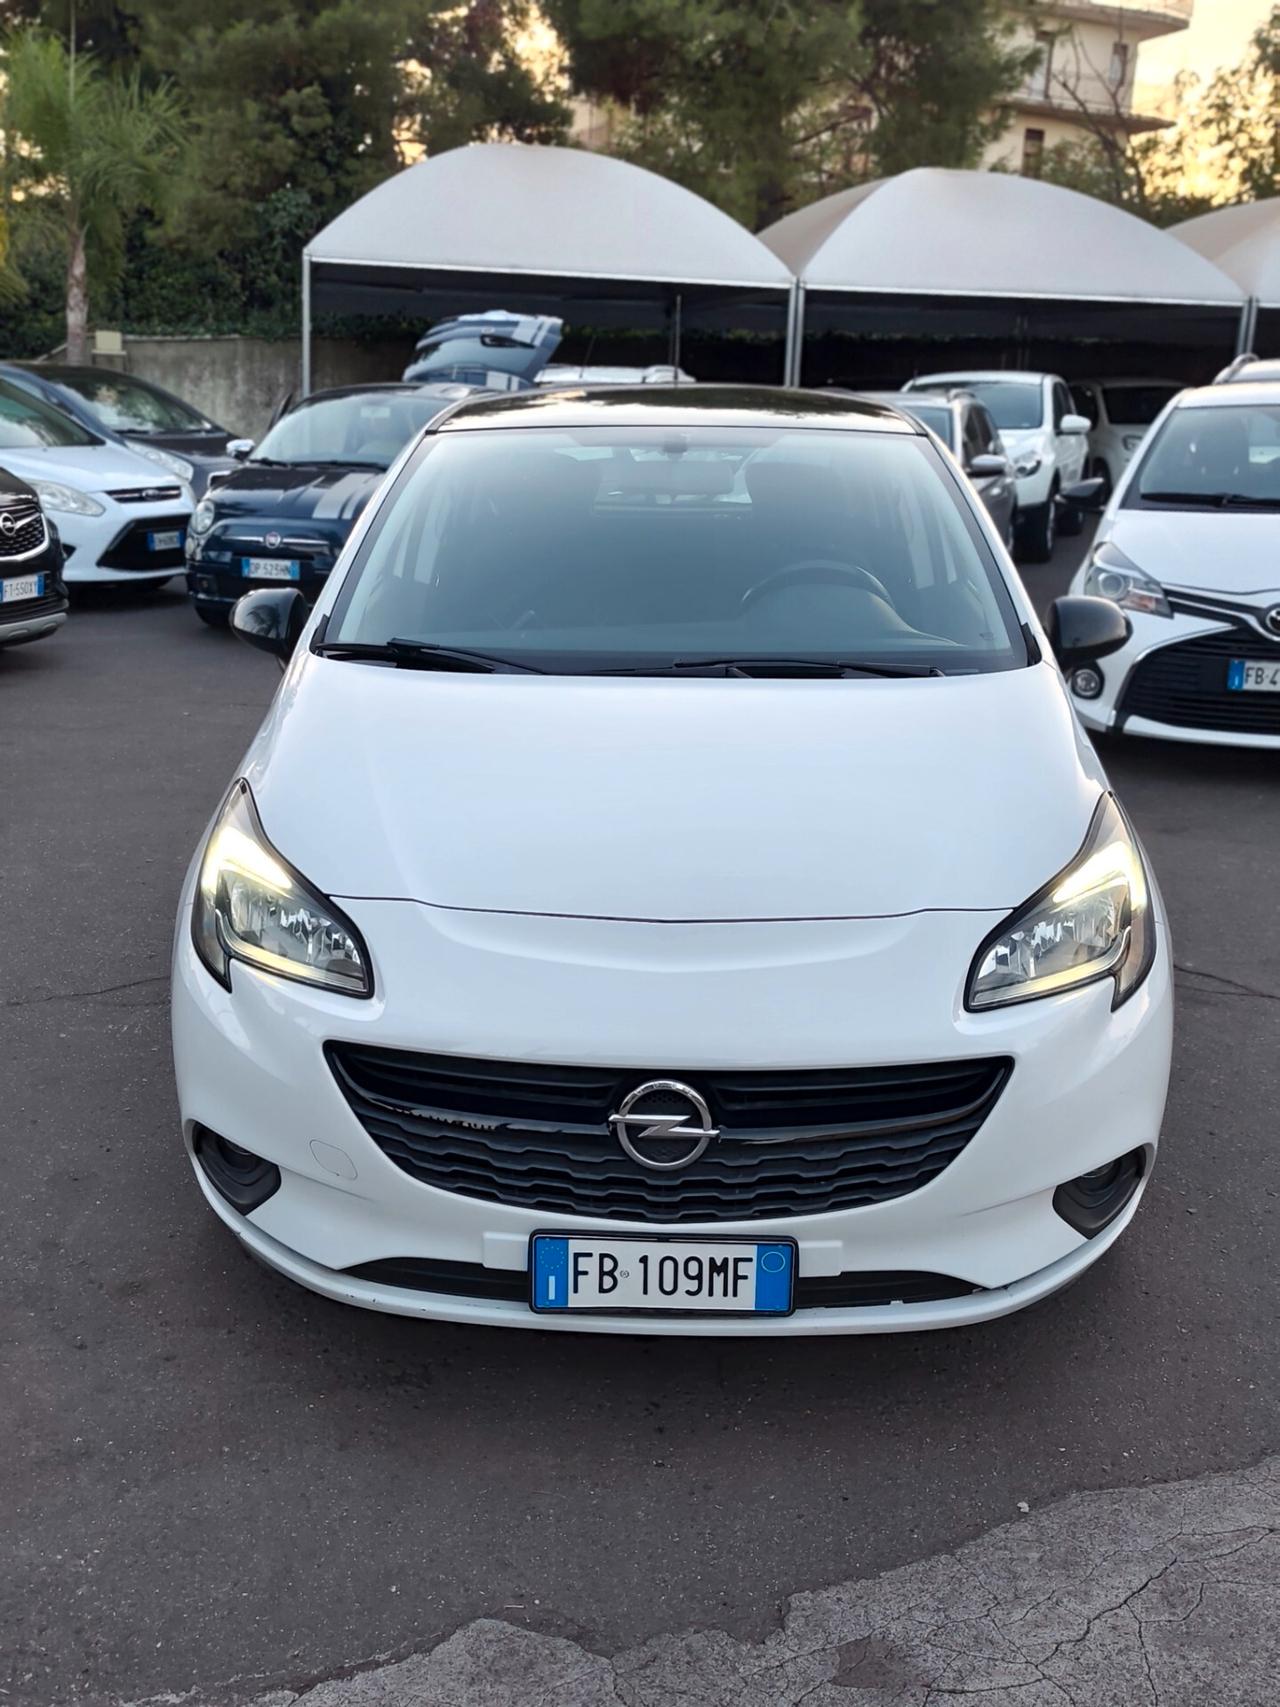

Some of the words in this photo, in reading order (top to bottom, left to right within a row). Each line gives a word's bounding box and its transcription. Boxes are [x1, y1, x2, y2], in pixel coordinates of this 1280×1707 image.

[1245, 666, 1265, 685] FB
[573, 1252, 618, 1294] FB
[638, 1254, 754, 1298] 109MF
